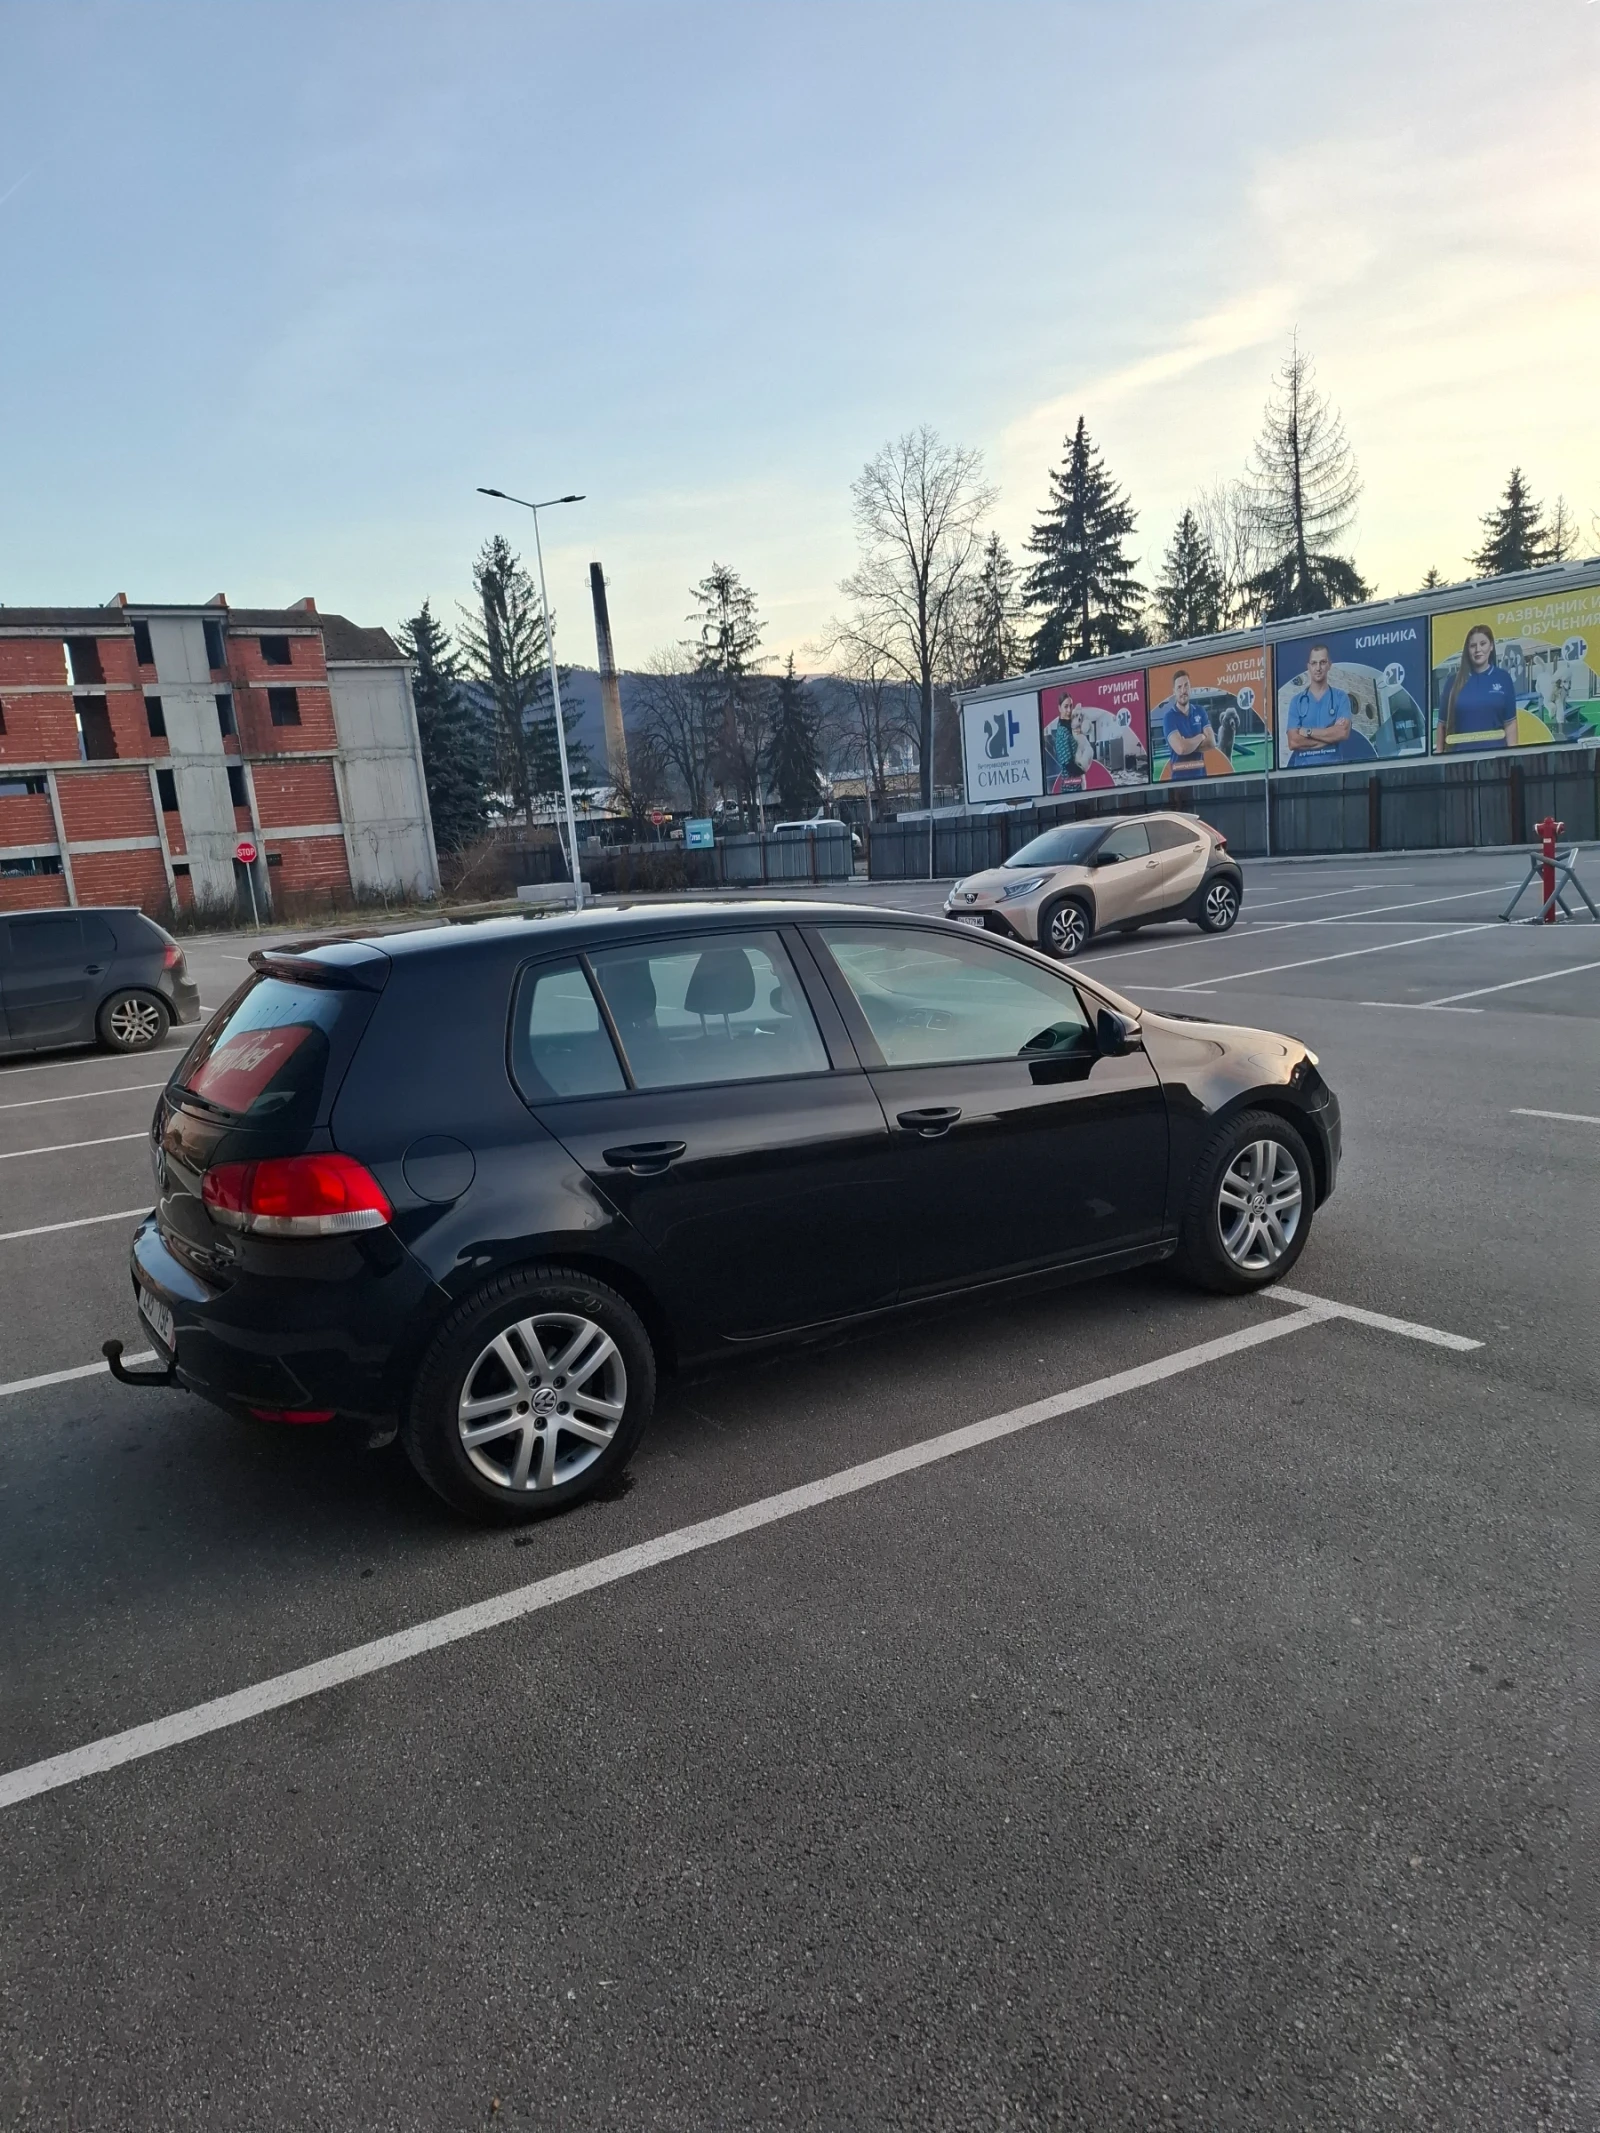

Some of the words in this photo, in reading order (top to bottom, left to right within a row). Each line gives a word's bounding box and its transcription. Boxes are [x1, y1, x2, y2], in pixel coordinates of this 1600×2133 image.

[1497, 597, 1588, 624] РАЗВЪДНИК
[1521, 612, 1600, 636] ОБУЧЕНИЯ
[1355, 628, 1417, 649] КЛИНИКА
[1225, 658, 1255, 672] ХОТЕЛ
[1257, 656, 1264, 667] И
[1216, 669, 1265, 686] УЧИЛИЩЕ
[1098, 679, 1139, 695] ГРУМИНГ
[1113, 694, 1120, 705] И
[1121, 691, 1140, 703] СПА
[978, 766, 1031, 787] СИМБА
[237, 847, 255, 857] STOP
